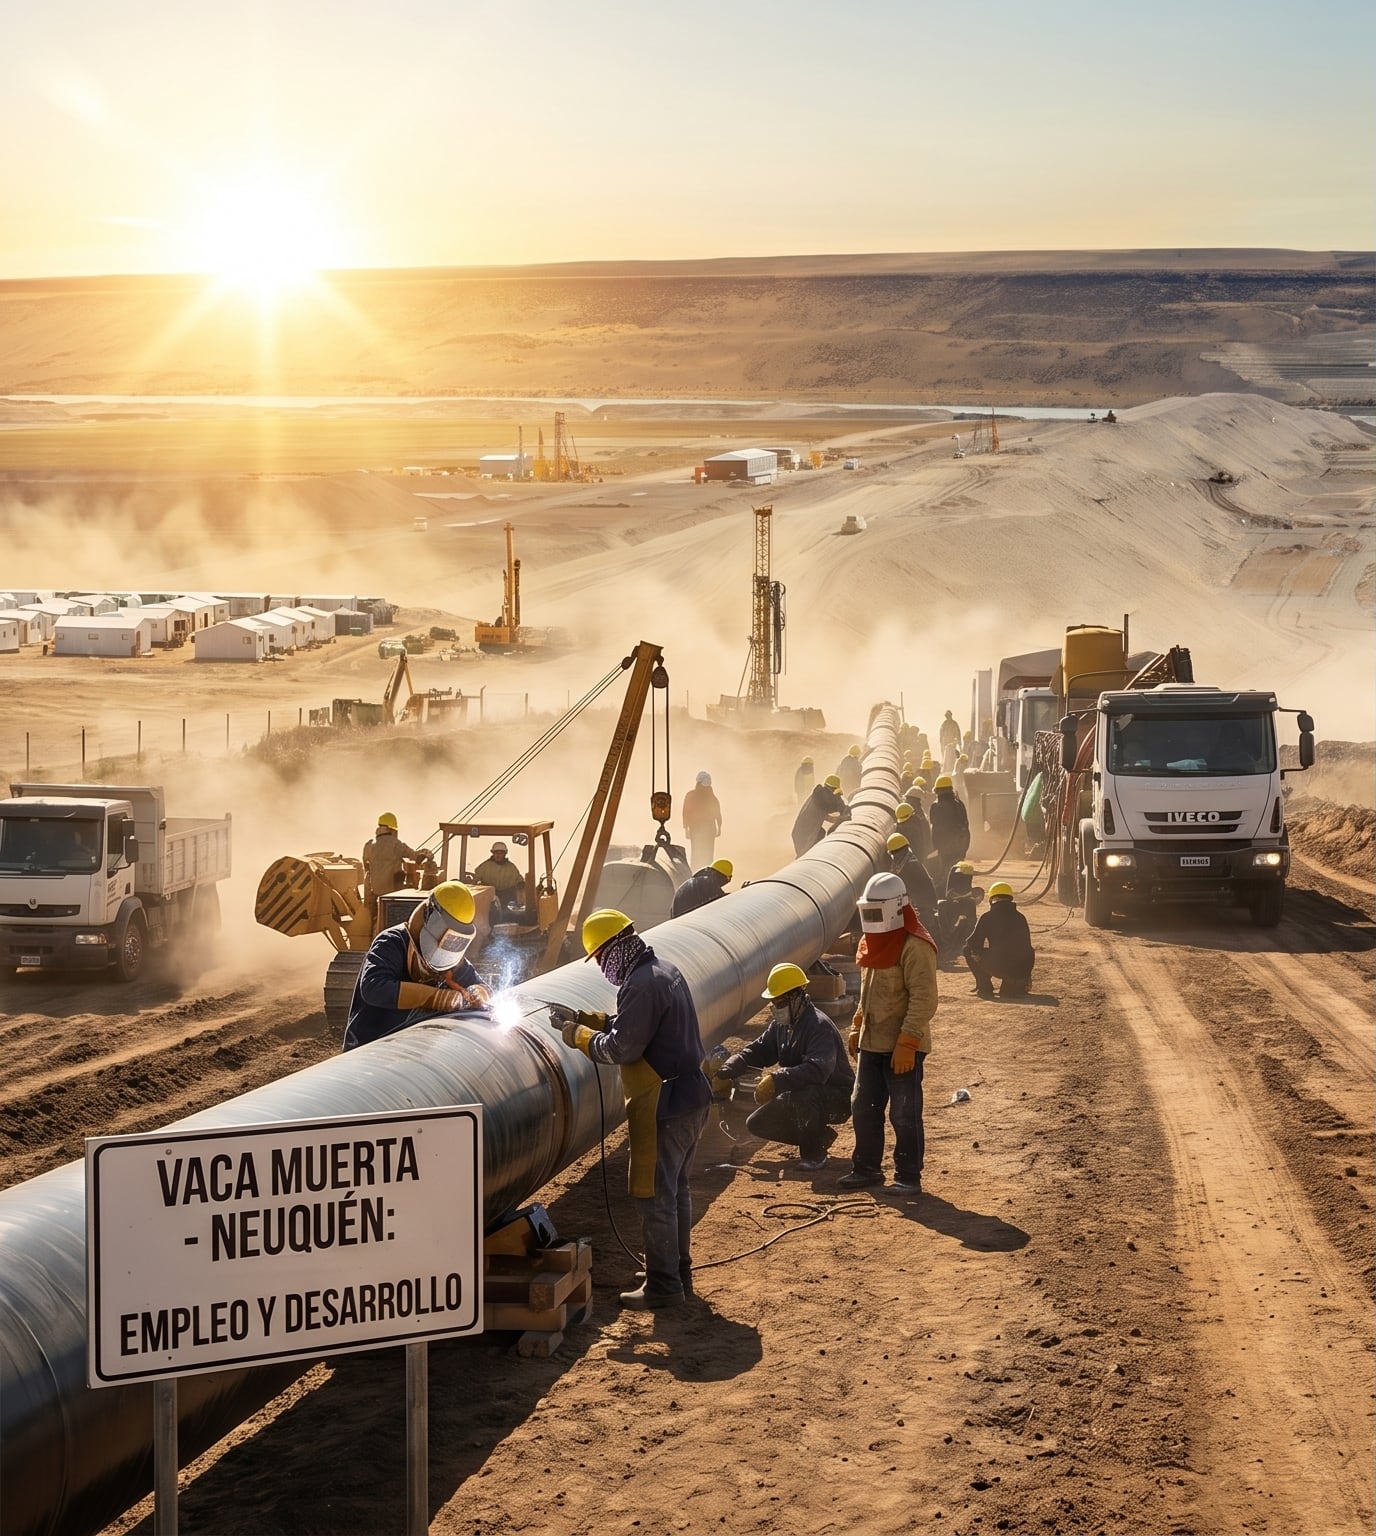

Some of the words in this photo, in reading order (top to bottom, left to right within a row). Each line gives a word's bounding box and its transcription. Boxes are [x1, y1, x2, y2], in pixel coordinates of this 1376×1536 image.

[1167, 811, 1220, 823] IVECO
[156, 1151, 260, 1208] VACA
[270, 1135, 420, 1197] MUERTA
[211, 1190, 396, 1262] NEUQUÉN:
[120, 1299, 249, 1358] EMPLEO
[256, 1295, 277, 1338] Y
[284, 1272, 463, 1335] DESARROLLO
